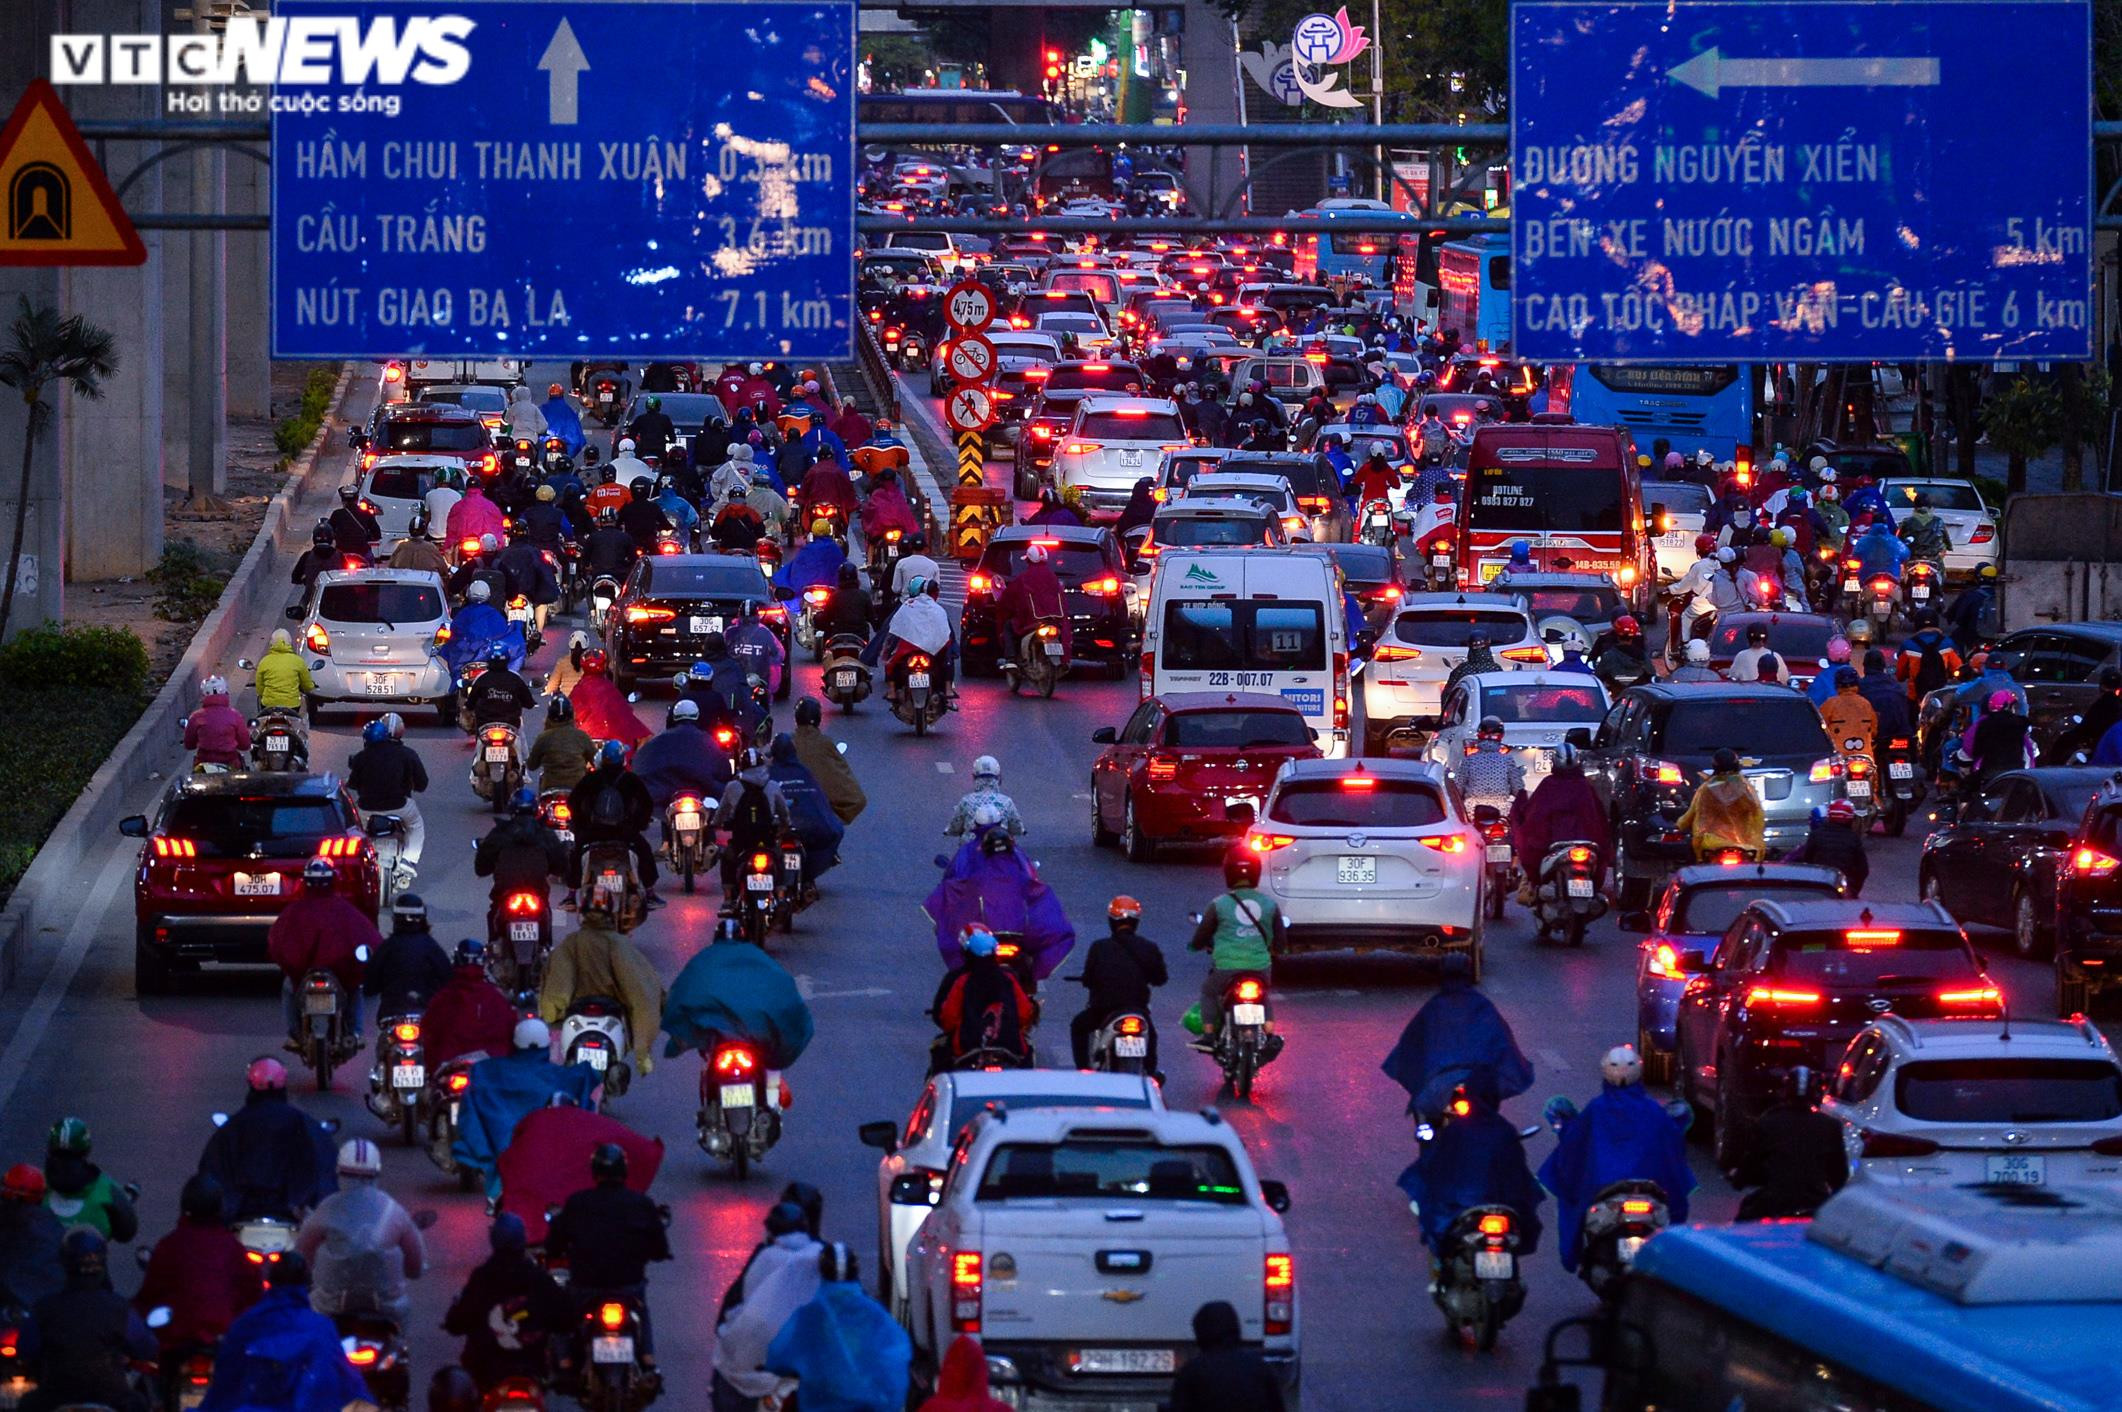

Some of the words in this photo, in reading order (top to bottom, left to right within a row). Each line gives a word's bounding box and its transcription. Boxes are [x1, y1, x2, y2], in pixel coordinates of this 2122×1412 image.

[296, 127, 367, 180] HẦM
[383, 141, 457, 180] CHUI
[474, 142, 582, 181] THANH
[599, 135, 688, 181] XUÂN
[1523, 133, 1639, 185] ĐƯỜNG
[1655, 130, 1785, 184] NGUYỄN
[1802, 126, 1878, 183] XIỂN
[296, 201, 359, 253] CẦU
[376, 198, 487, 254] TRẮNG
[782, 215, 832, 256] km
[1525, 208, 1590, 258] BẾN
[1607, 219, 1648, 258] XE
[1664, 207, 1755, 258] NƯỚC
[1768, 204, 1866, 257] NGẦM
[2036, 217, 2086, 255] km
[296, 277, 361, 326] NÚT
[378, 288, 453, 328] GIAO
[469, 288, 511, 328] BA
[526, 288, 570, 328] LA
[781, 291, 833, 330] km
[1525, 292, 1592, 332] CAO
[1676, 280, 1760, 332] PHÁP
[2001, 290, 2020, 328] 6
[2036, 290, 2086, 328] km
[1275, 634, 1298, 650] 11
[373, 675, 390, 684] 30F
[239, 884, 275, 894] 475.07
[1339, 870, 1376, 882] 936.35
[1347, 857, 1366, 869] 30F
